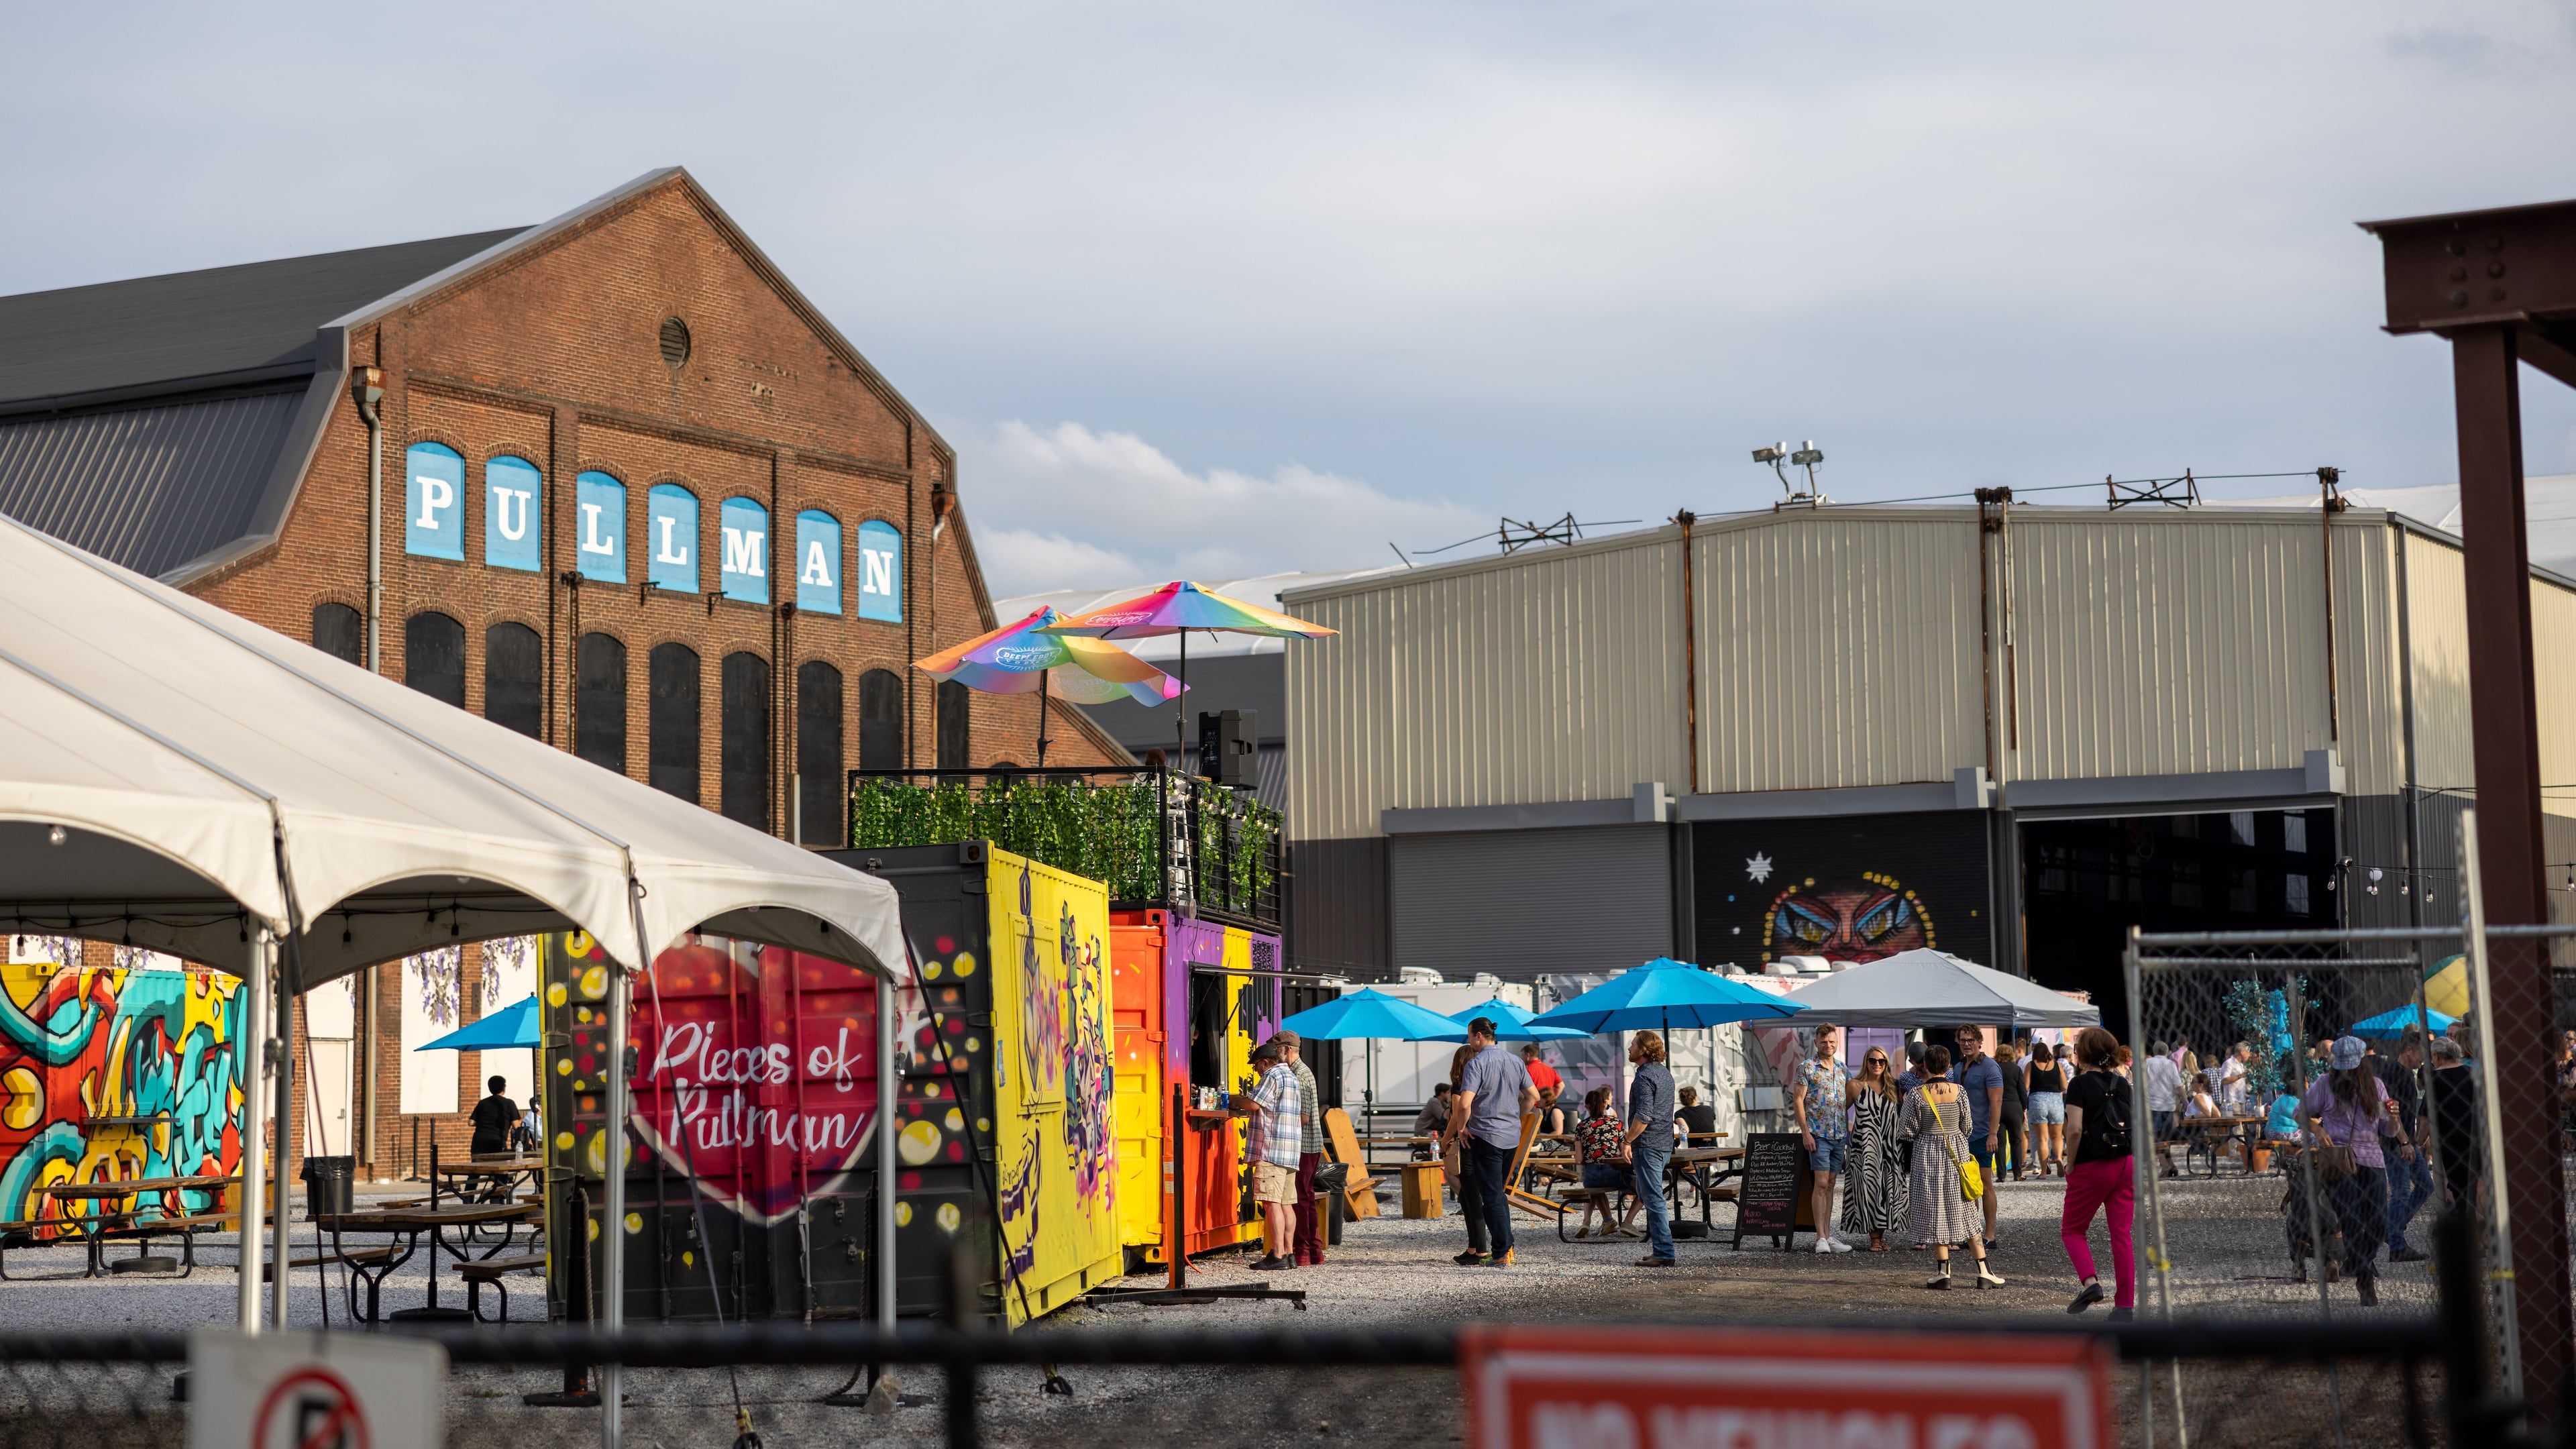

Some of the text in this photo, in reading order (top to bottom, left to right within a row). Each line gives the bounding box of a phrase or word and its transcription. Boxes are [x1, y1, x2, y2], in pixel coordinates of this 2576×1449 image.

[416, 476, 893, 596] PULLMAN
[1004, 651, 1055, 660] DEEP EDDY
[647, 1021, 863, 1092] Pieces of
[669, 1077, 865, 1152] Pullman
[1754, 1141, 1770, 1152] Beer
